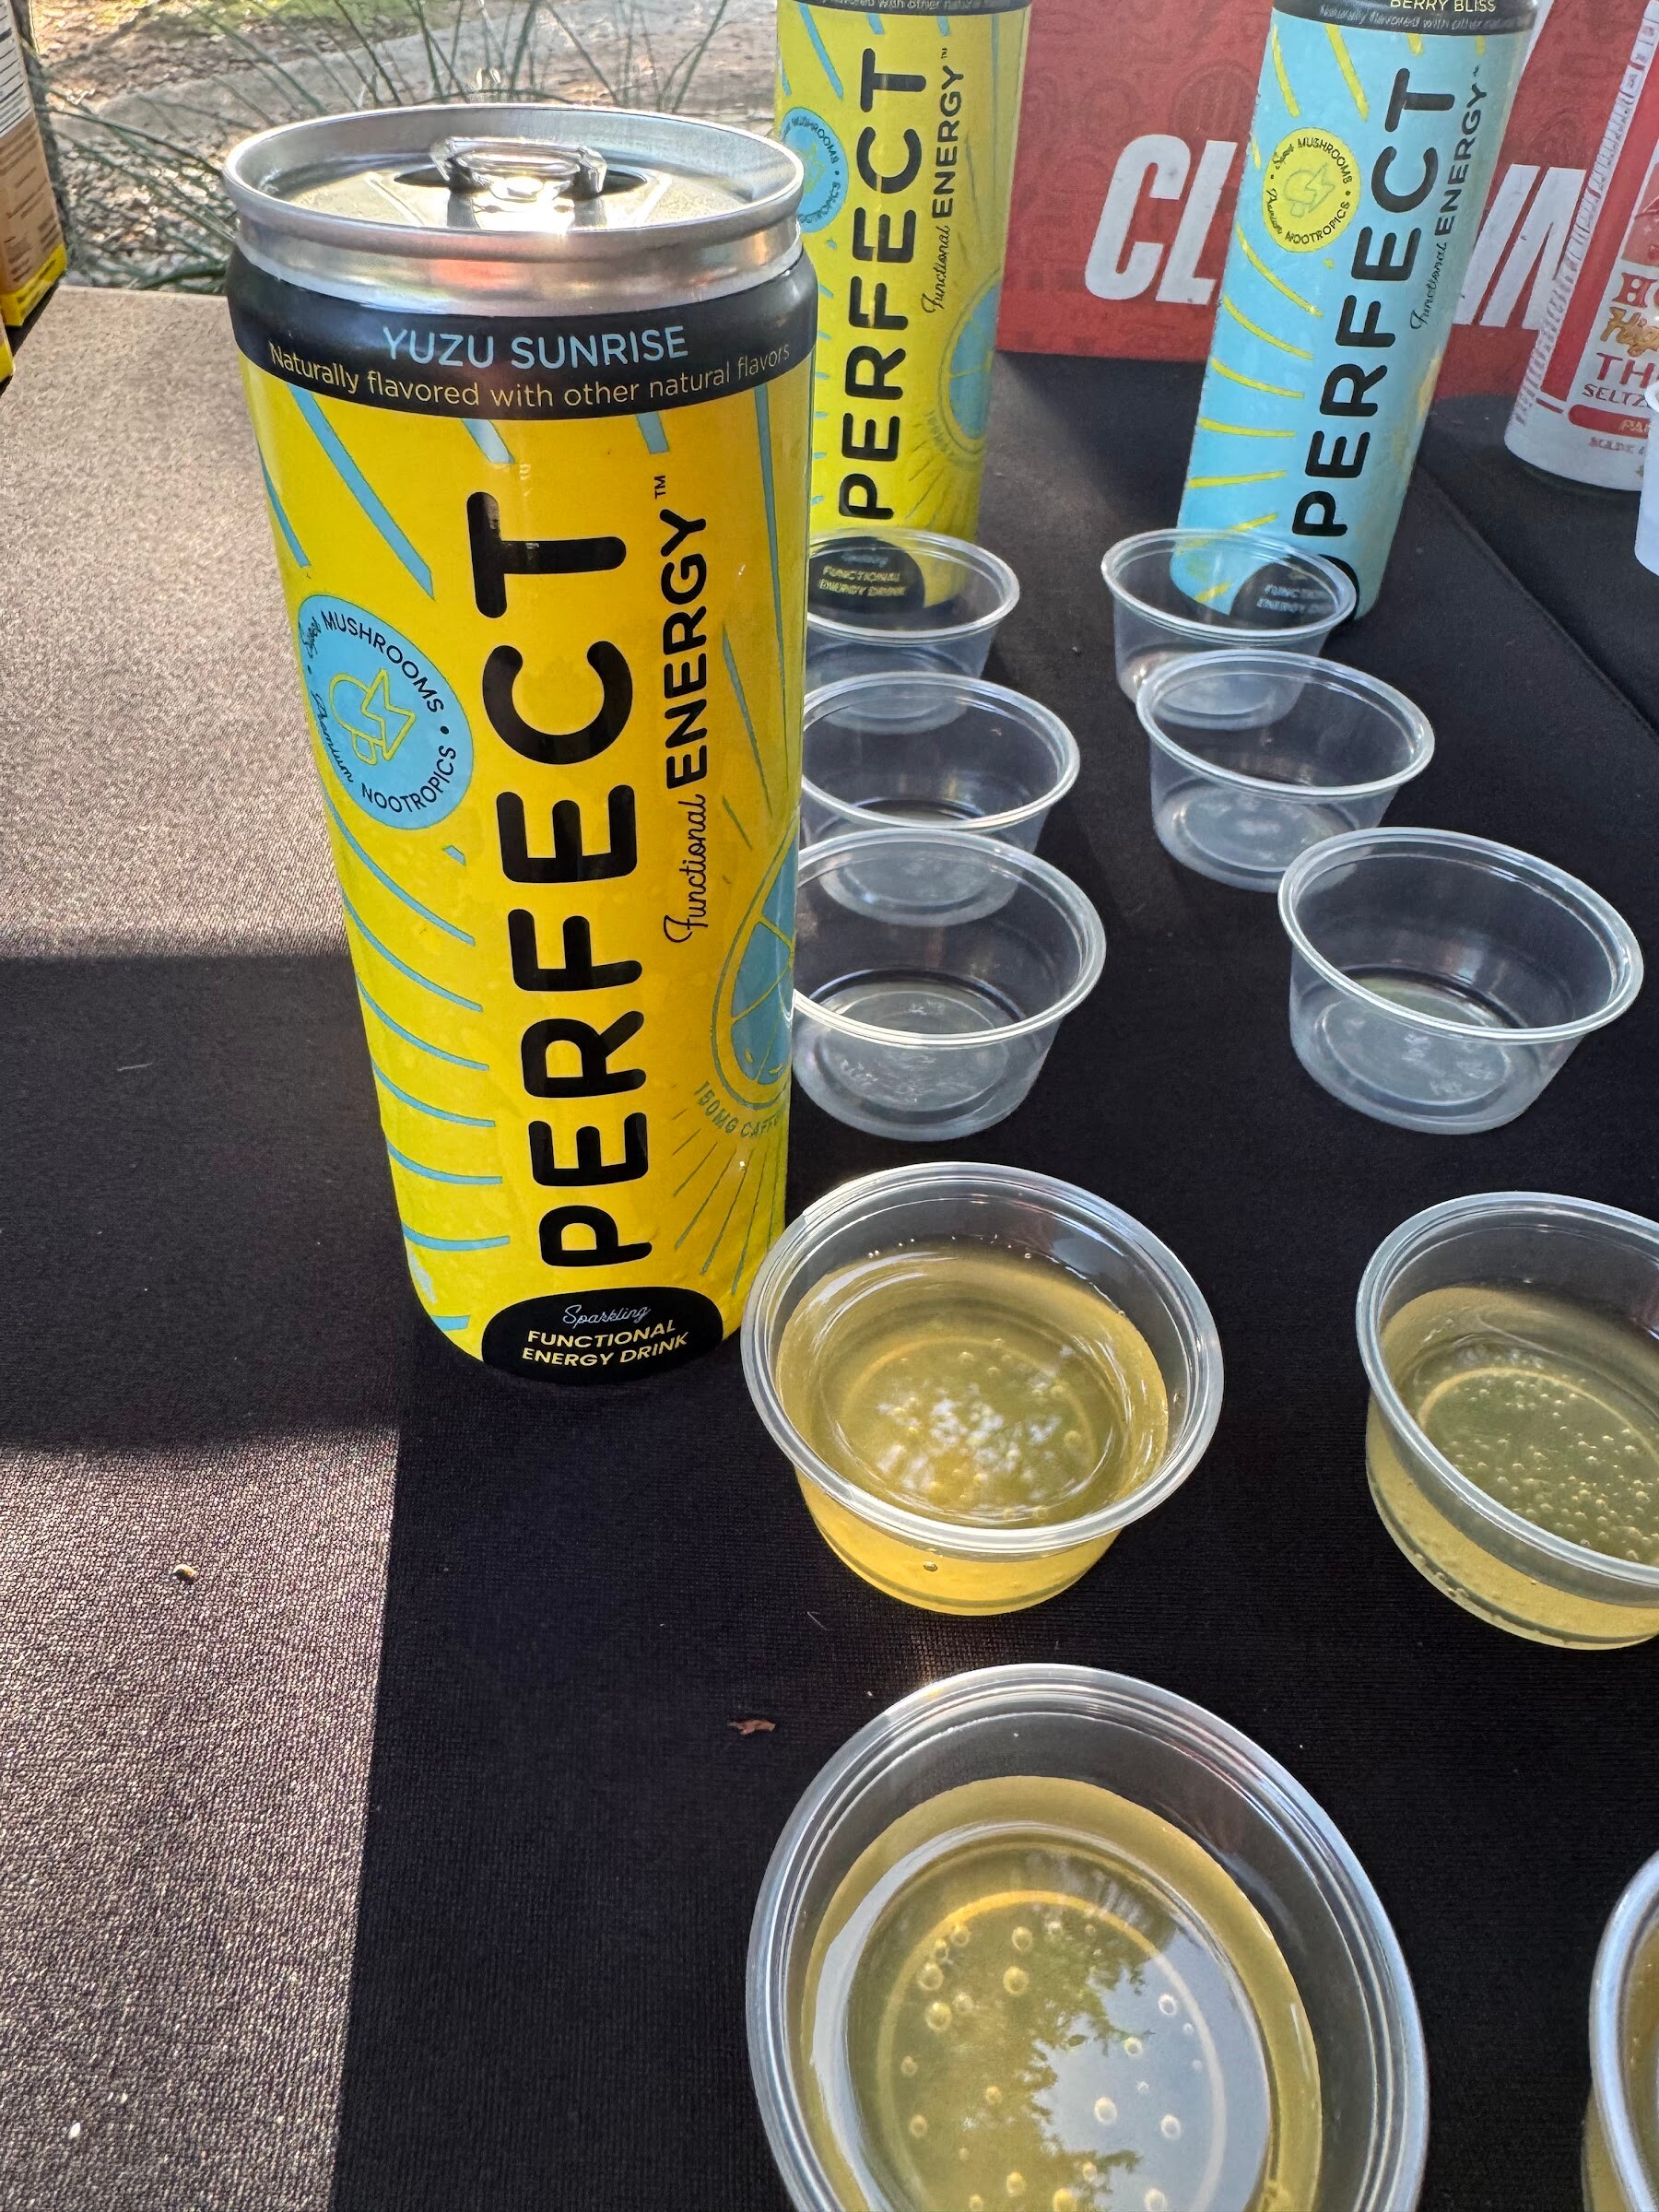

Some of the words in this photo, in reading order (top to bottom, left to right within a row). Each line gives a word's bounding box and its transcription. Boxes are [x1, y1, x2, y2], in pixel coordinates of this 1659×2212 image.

[1453, 0, 1497, 13] BLISS
[932, 65, 964, 219] ENERGY
[1435, 83, 1487, 236] ENERGY
[839, 48, 926, 520] PERFECT
[921, 225, 951, 314] Functional
[1292, 68, 1454, 537] PERFECT
[267, 339, 359, 394] Naturally
[367, 371, 480, 406] flavored
[490, 381, 554, 407] with
[563, 382, 639, 406] other
[649, 361, 730, 398] natural
[737, 344, 791, 380] flavors
[382, 325, 494, 369] YUZU
[511, 325, 688, 370] SUNRISE
[321, 611, 444, 712] MUSHROOMS
[659, 509, 707, 790] ENERGY
[361, 745, 456, 813] NOOTROPICS
[466, 491, 653, 1268] PERFECT
[664, 794, 707, 944] Functional
[522, 1347, 615, 1367] ENERGY
[619, 1331, 689, 1364] DRINK
[527, 1319, 677, 1348] FUNCTIONAL
[562, 1304, 652, 1330] Sparkling
